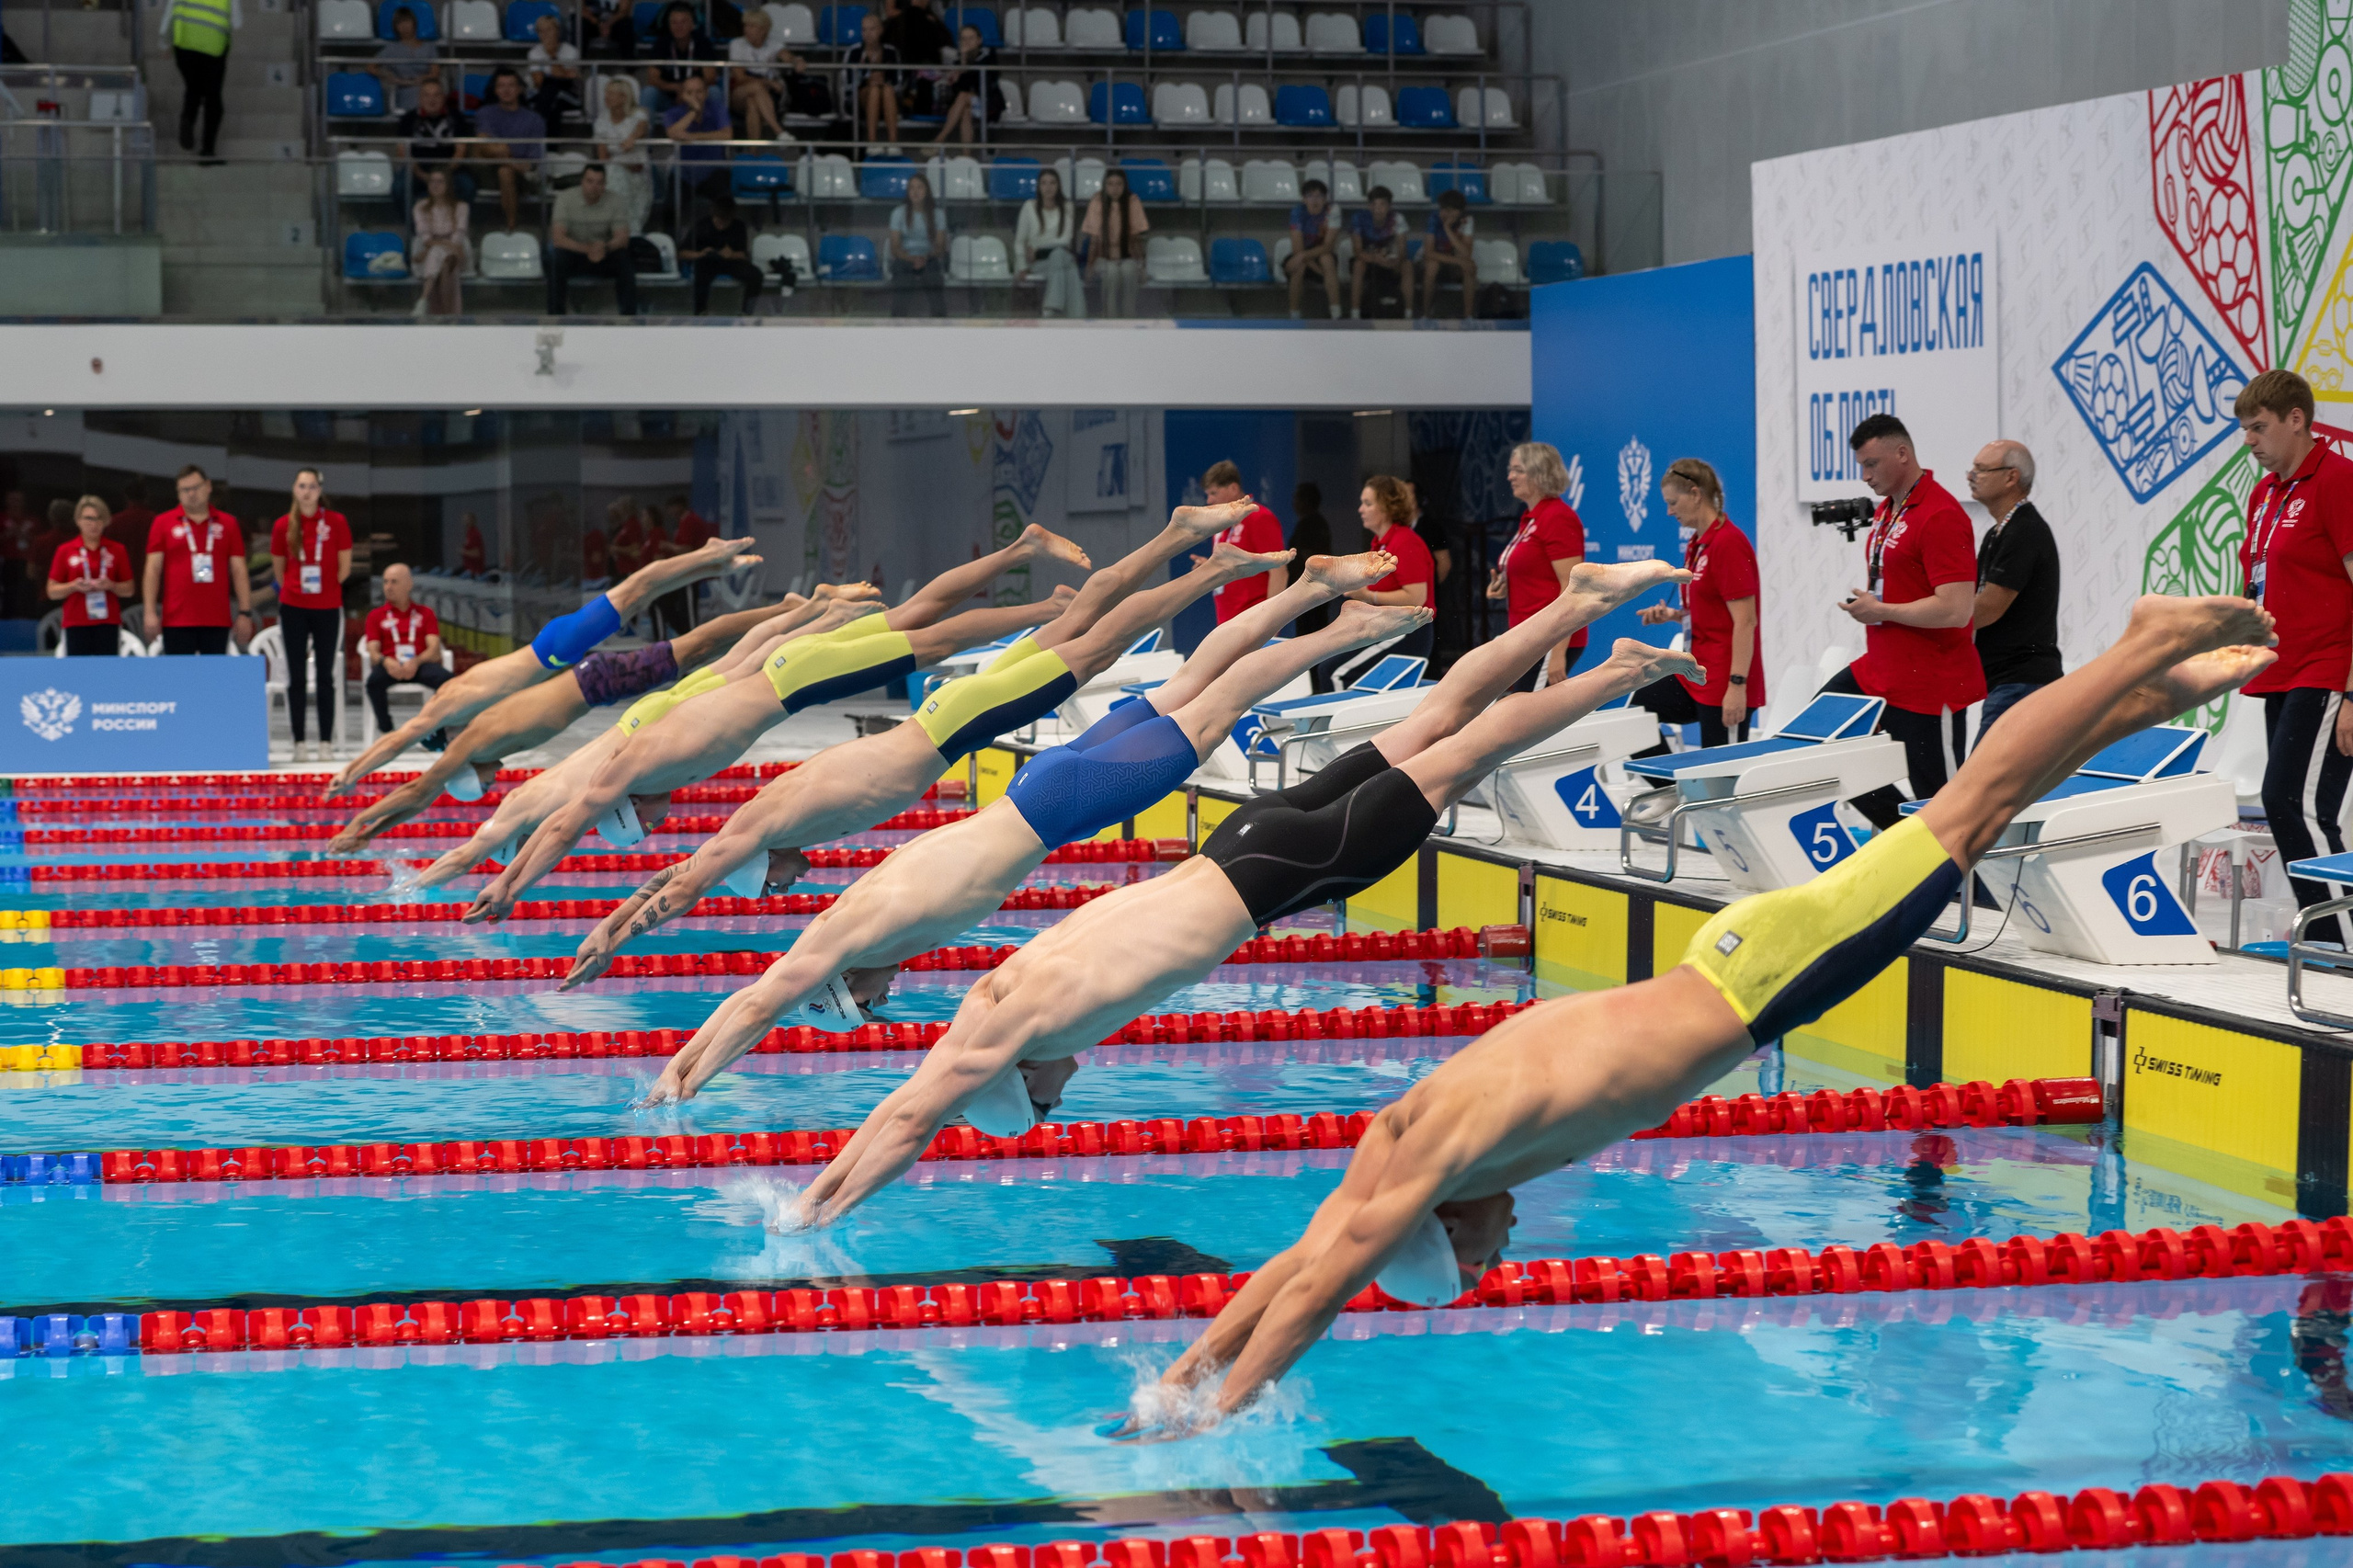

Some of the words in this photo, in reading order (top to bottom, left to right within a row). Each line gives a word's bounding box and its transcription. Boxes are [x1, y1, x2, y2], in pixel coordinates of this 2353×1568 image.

[1808, 252, 1984, 360] СВЕРДЛОВСКАЯ
[92, 701, 176, 714] МИНСПОРТ
[92, 718, 157, 731] РОССИИ
[1574, 784, 1599, 820] 4
[1713, 829, 1749, 873] 5
[1812, 822, 1838, 863] 5
[2010, 883, 2052, 934] 6
[2128, 874, 2157, 922] 6
[2147, 1057, 2184, 1077] SWISS
[2184, 1065, 2222, 1086] TIMING
